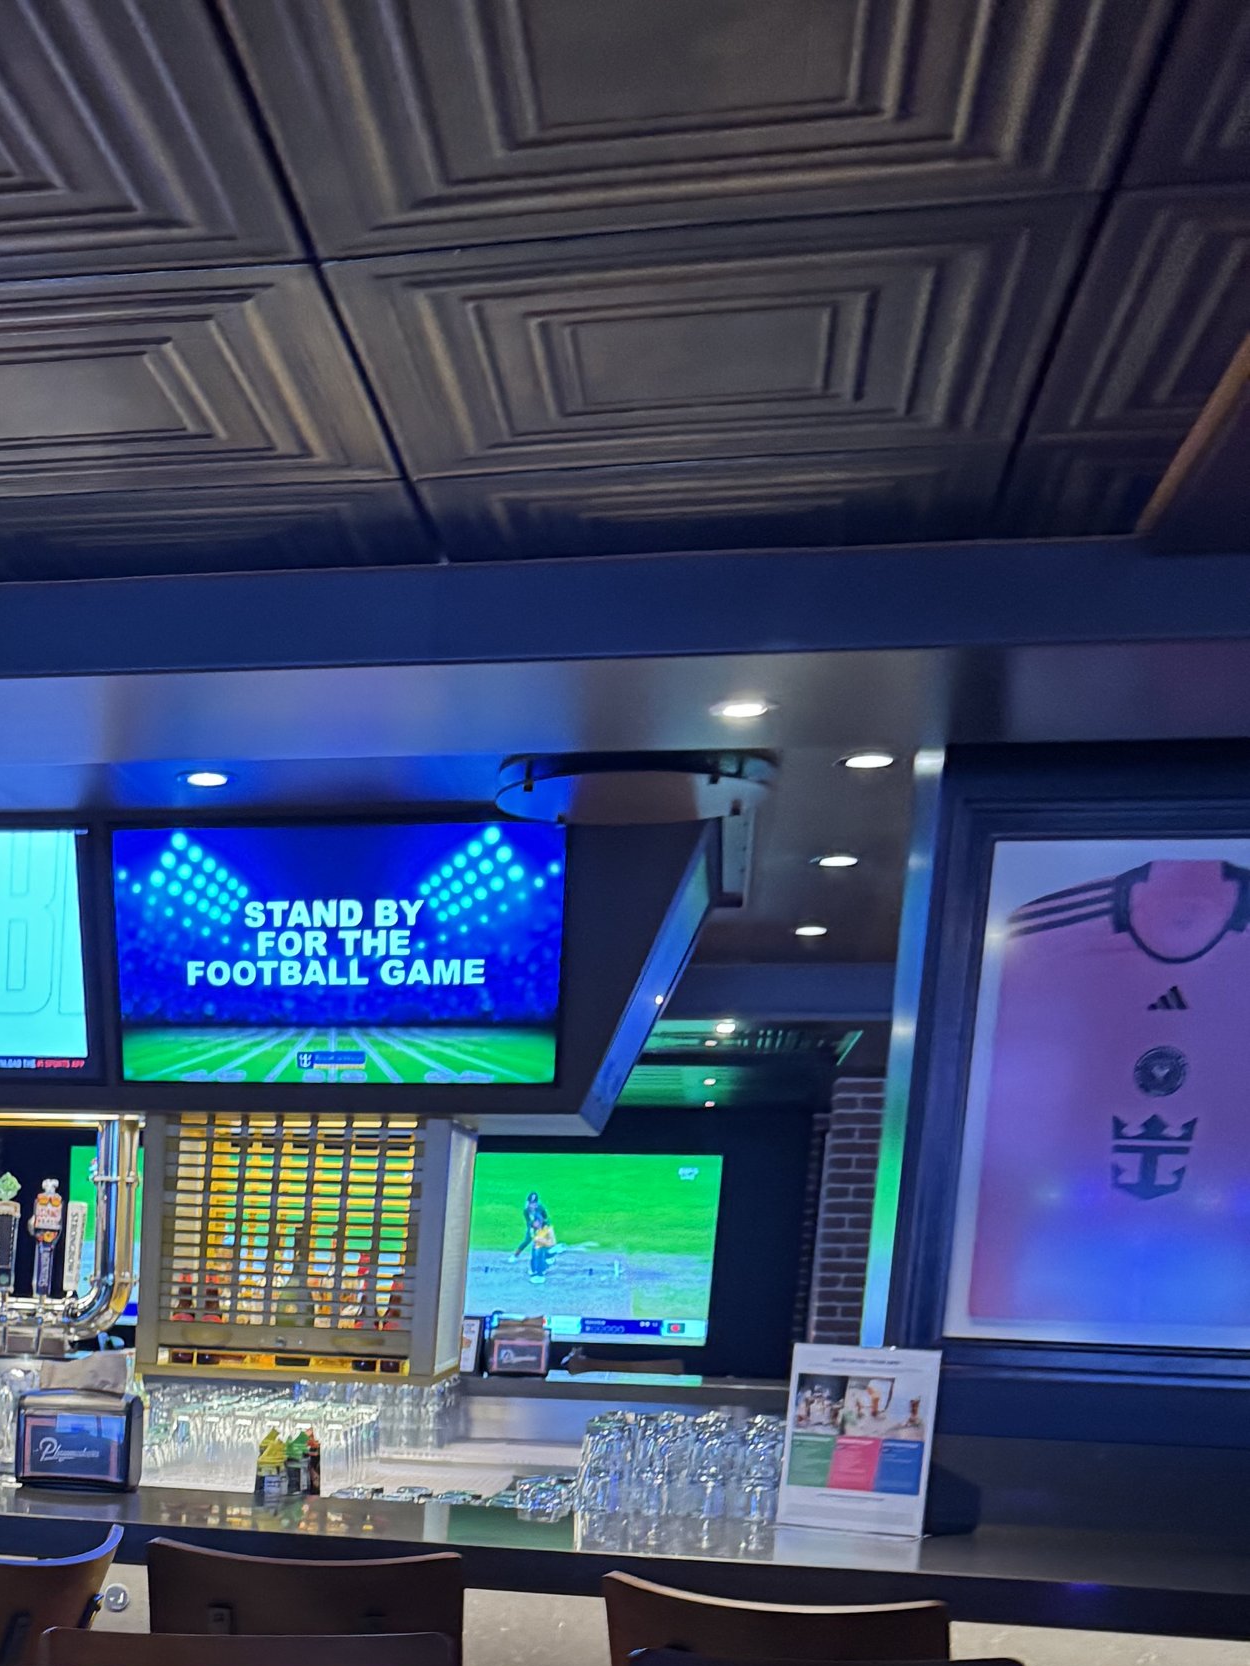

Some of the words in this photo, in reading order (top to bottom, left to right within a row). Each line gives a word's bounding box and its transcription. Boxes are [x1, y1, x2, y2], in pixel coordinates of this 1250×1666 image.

[244, 899, 363, 928] STAND
[375, 899, 424, 927] BY
[257, 931, 327, 957] FOR
[338, 929, 410, 956] THE
[187, 959, 369, 986] FOOTBALL
[380, 959, 485, 986] GAME
